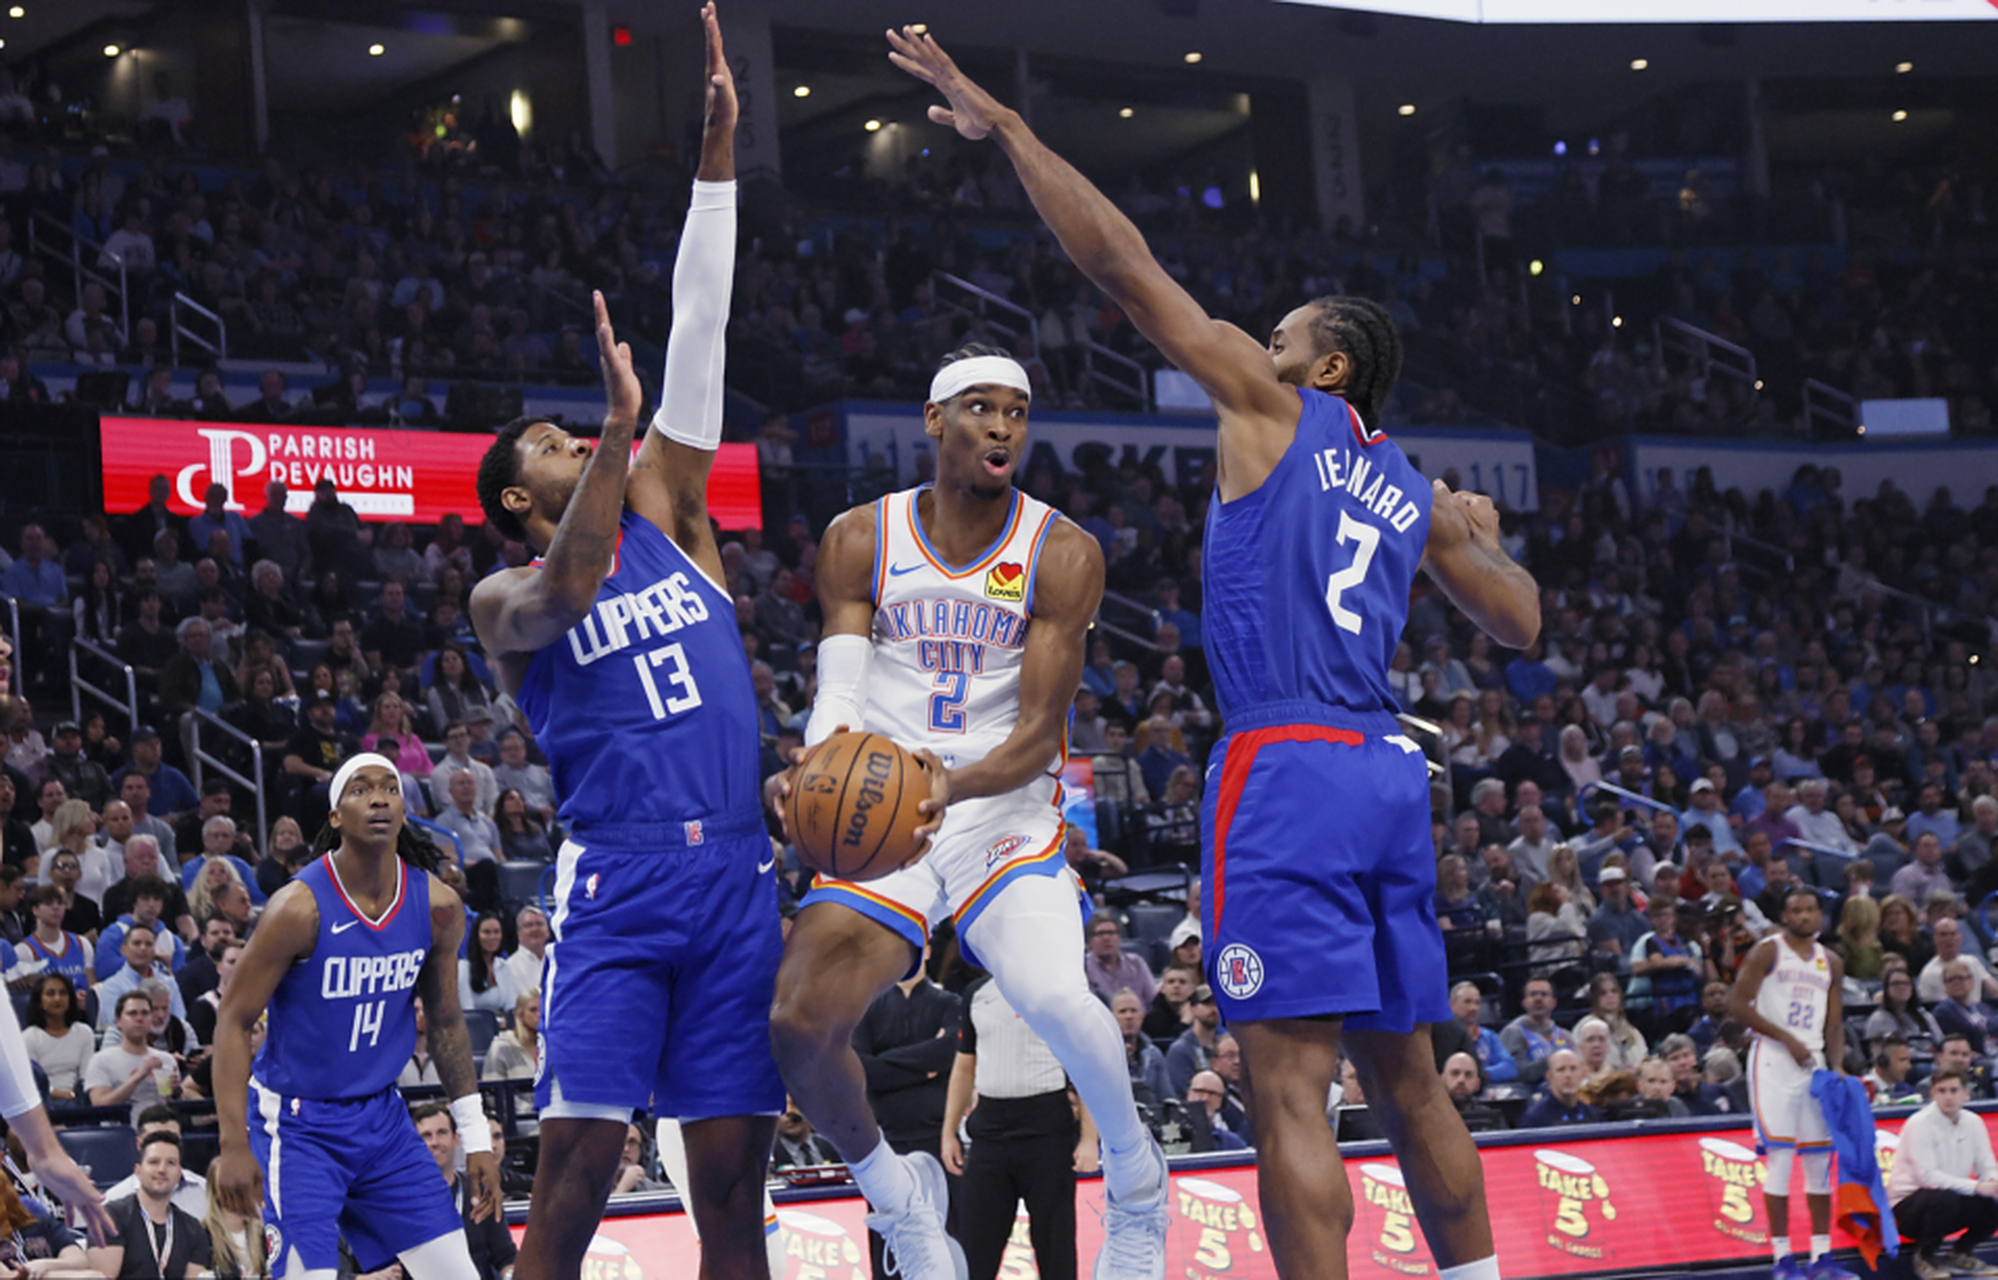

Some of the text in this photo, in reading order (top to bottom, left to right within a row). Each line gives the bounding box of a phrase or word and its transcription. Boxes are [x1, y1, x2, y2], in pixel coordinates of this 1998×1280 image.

[269, 433, 376, 461] PARRISH
[270, 461, 413, 489] DEVAUGHN
[1471, 461, 1528, 507] 117
[1325, 508, 1381, 636] 2
[917, 639, 986, 675] CITY
[633, 642, 703, 721] 13
[928, 670, 972, 735] 2
[842, 751, 894, 847] Wilson
[321, 948, 426, 999] CLIPPERS
[348, 999, 386, 1052] 14
[1788, 1001, 1815, 1030] 22
[1536, 1162, 1594, 1201] TAKE
[1701, 1150, 1757, 1188] TAKE
[1177, 1191, 1239, 1232] TAKE
[1361, 1176, 1415, 1214] TAK
[1719, 1184, 1754, 1224] 5
[1380, 1211, 1417, 1254] 5
[1555, 1196, 1590, 1238] 5
[1194, 1227, 1233, 1271] 5
